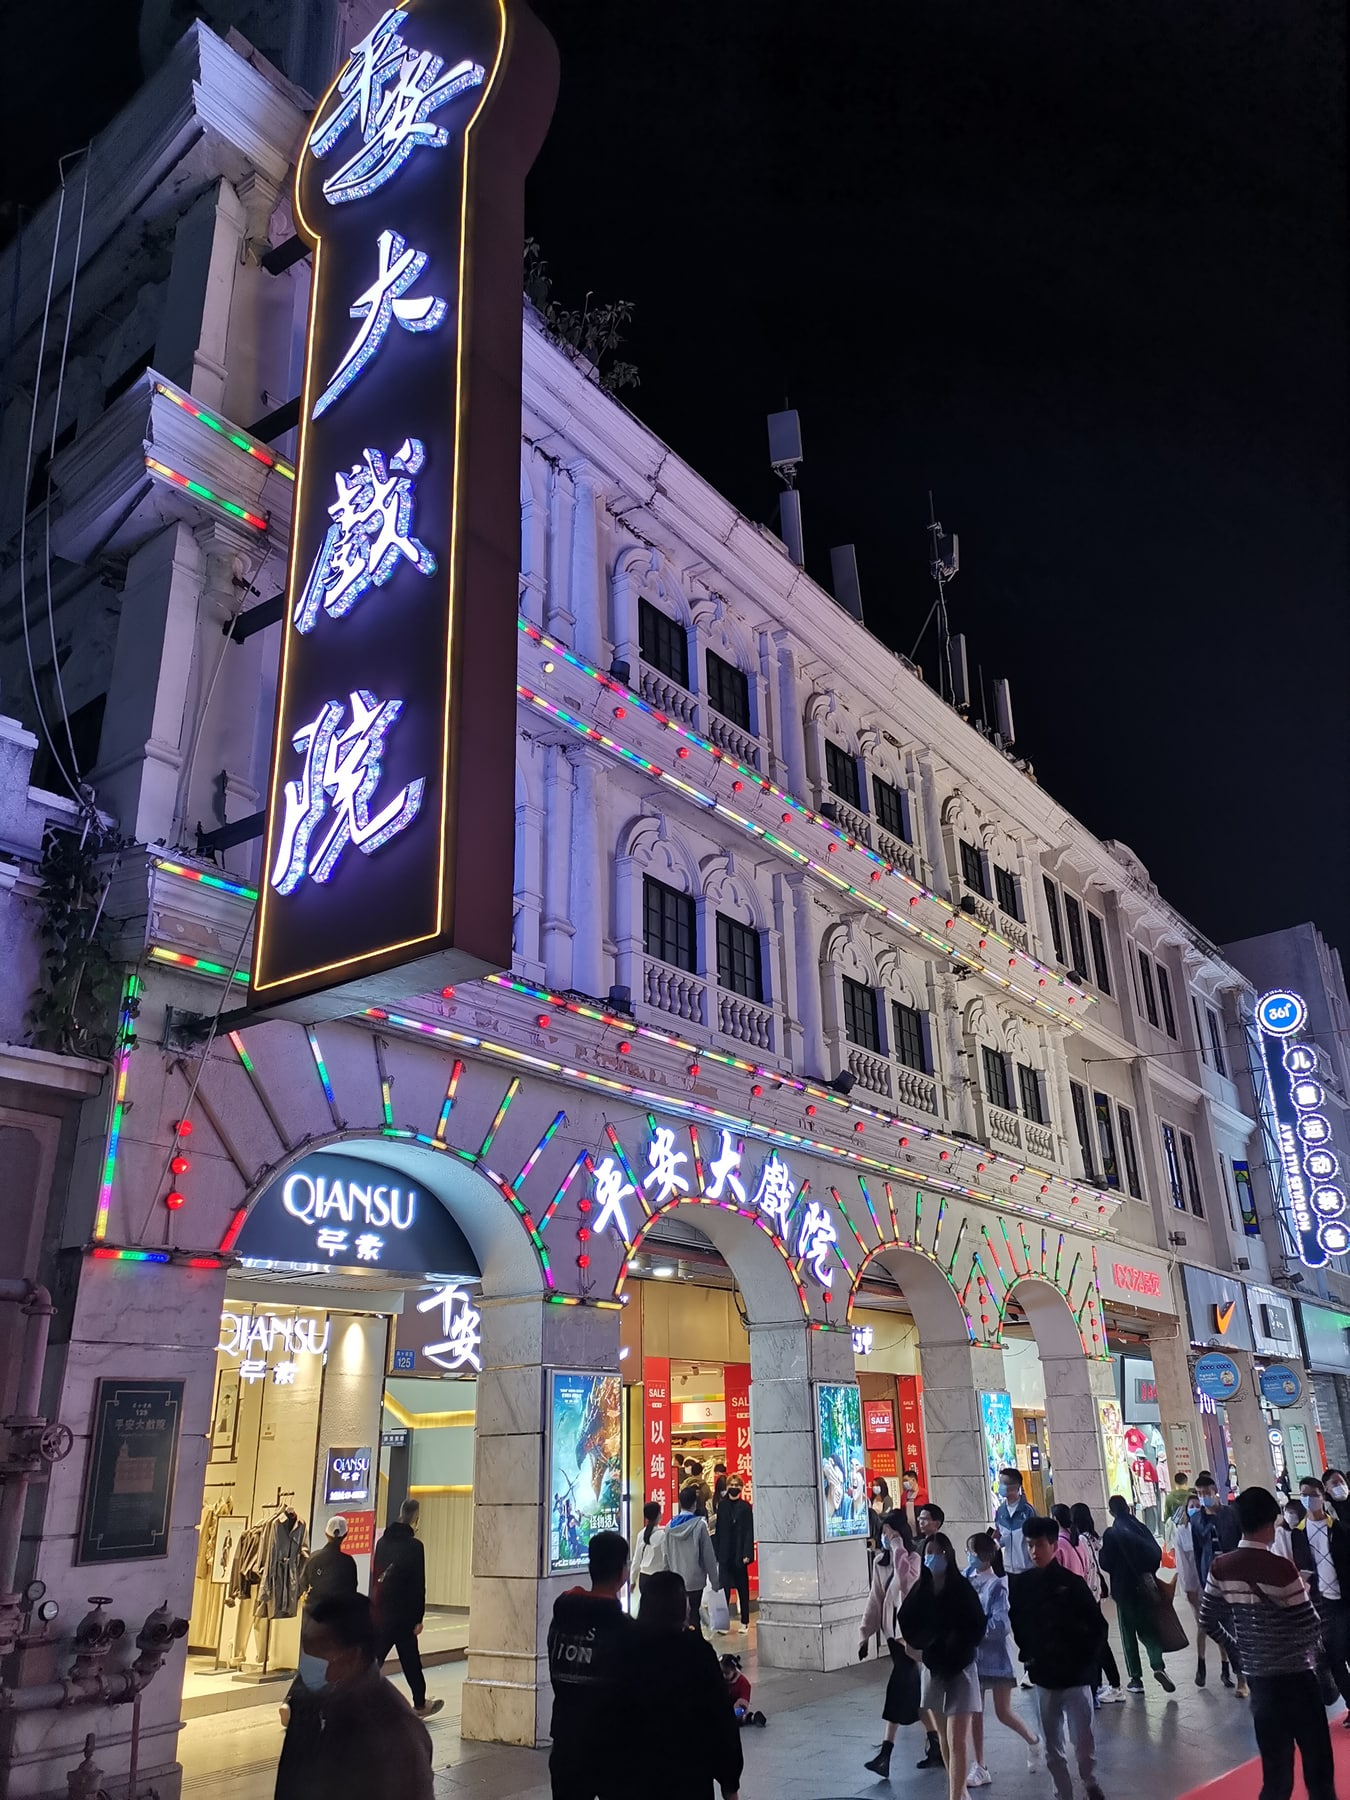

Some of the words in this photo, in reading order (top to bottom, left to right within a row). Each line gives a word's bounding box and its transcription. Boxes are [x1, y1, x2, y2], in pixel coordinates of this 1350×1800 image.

[1280, 1124, 1297, 1153] PLAY
[1286, 1153, 1301, 1175] ALL
[283, 1171, 416, 1229] QIANSU
[218, 1313, 330, 1357] QIANSU
[398, 1357, 411, 1368] 125
[648, 1388, 666, 1398] SALE
[731, 1396, 750, 1407] SAL
[870, 1416, 890, 1425] SALE
